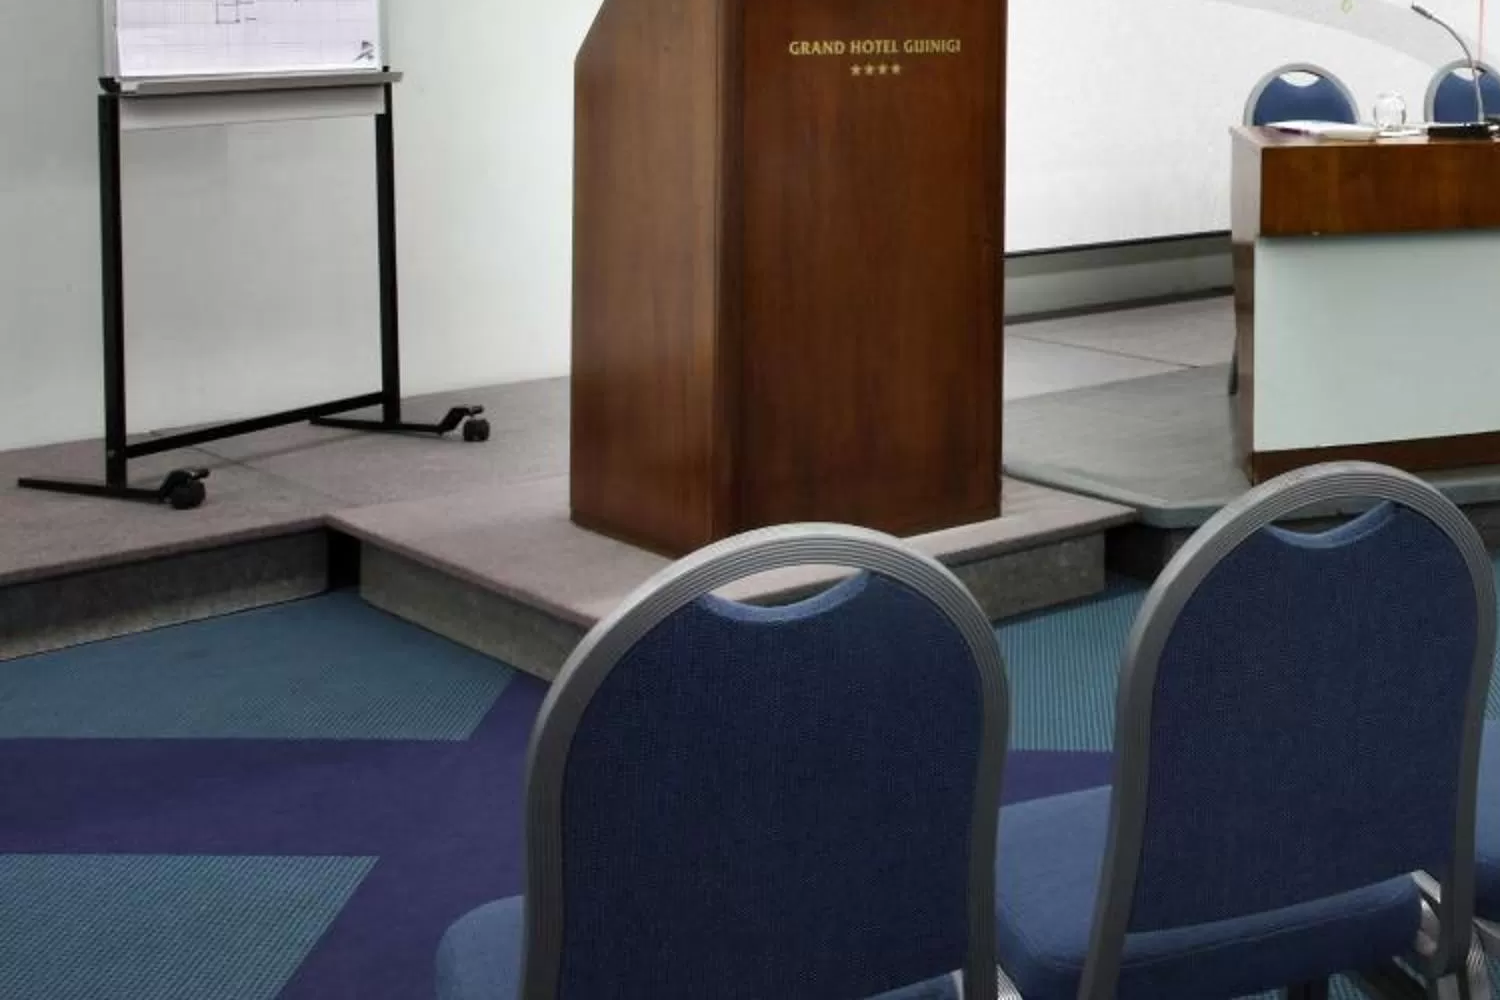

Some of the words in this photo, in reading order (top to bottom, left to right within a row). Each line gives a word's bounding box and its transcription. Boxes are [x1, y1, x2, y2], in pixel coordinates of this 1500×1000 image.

[788, 40, 846, 56] GRAND
[850, 39, 900, 54] HOTEL
[903, 38, 961, 54] GUINIGI
